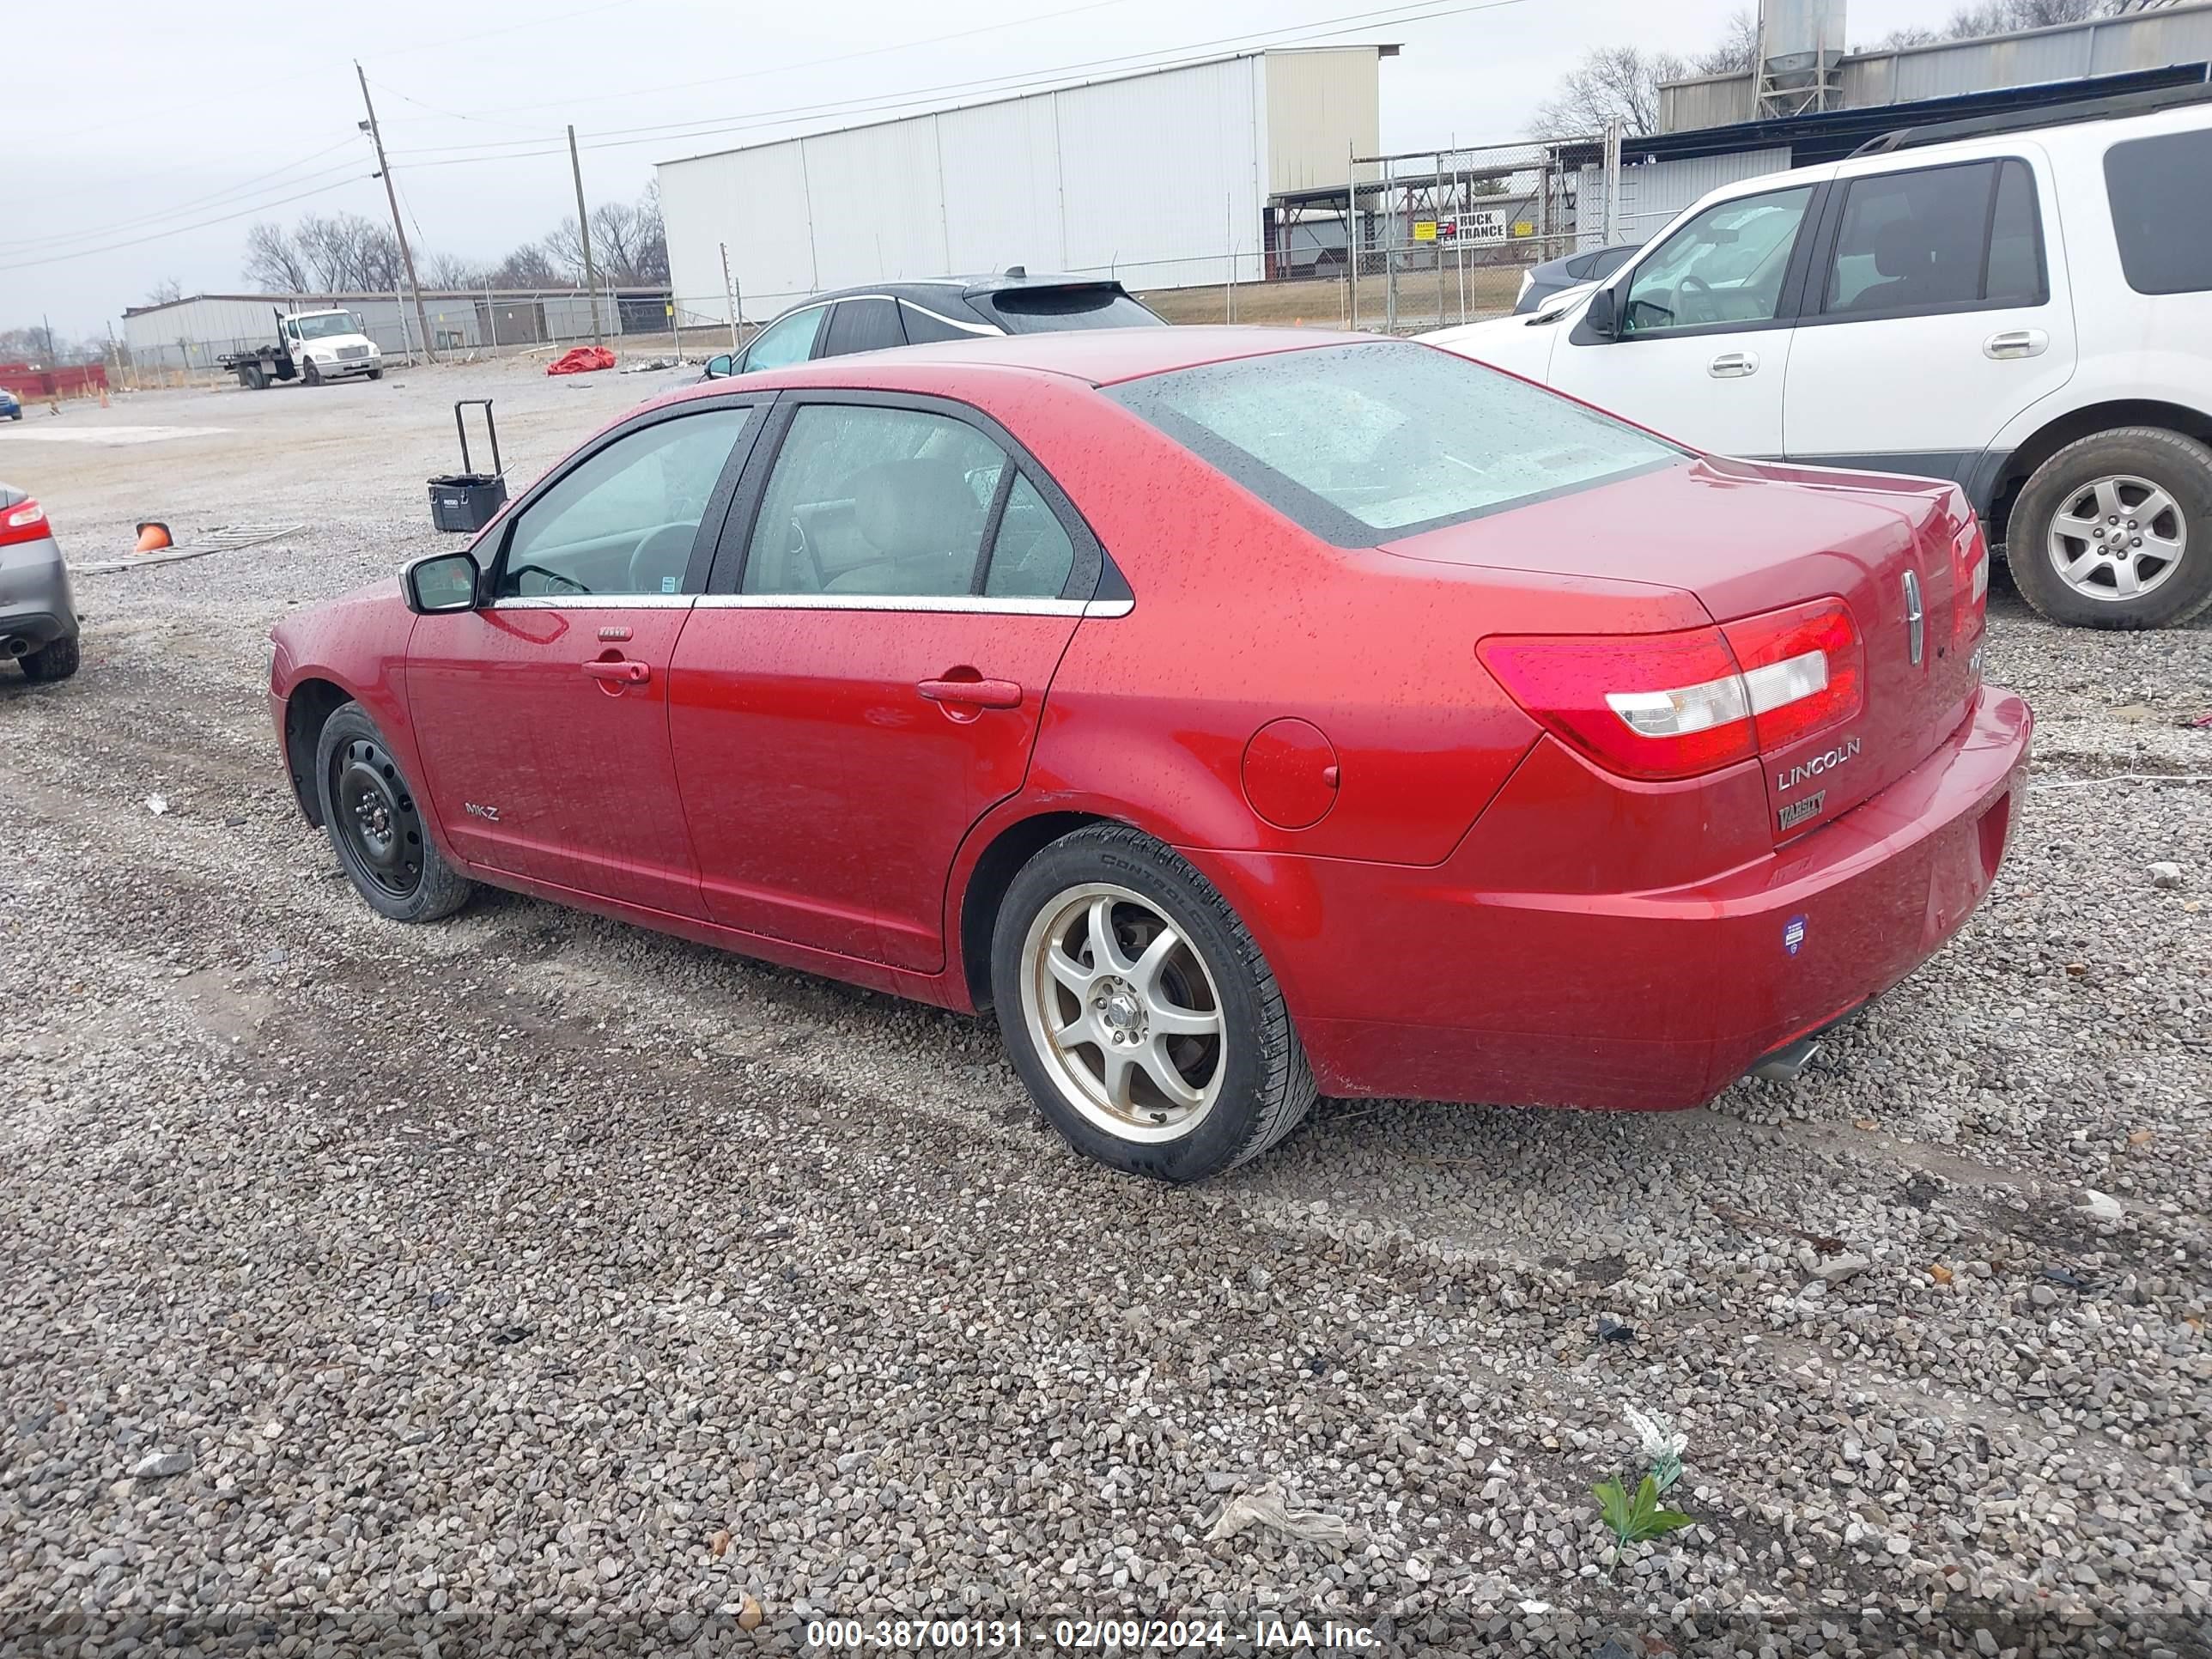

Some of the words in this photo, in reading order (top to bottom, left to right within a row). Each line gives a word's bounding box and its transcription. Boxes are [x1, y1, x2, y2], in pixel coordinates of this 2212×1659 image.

[1778, 738, 1861, 791] LINCOLN
[465, 802, 500, 821] MKZ
[1778, 789, 1826, 831] VARSITY
